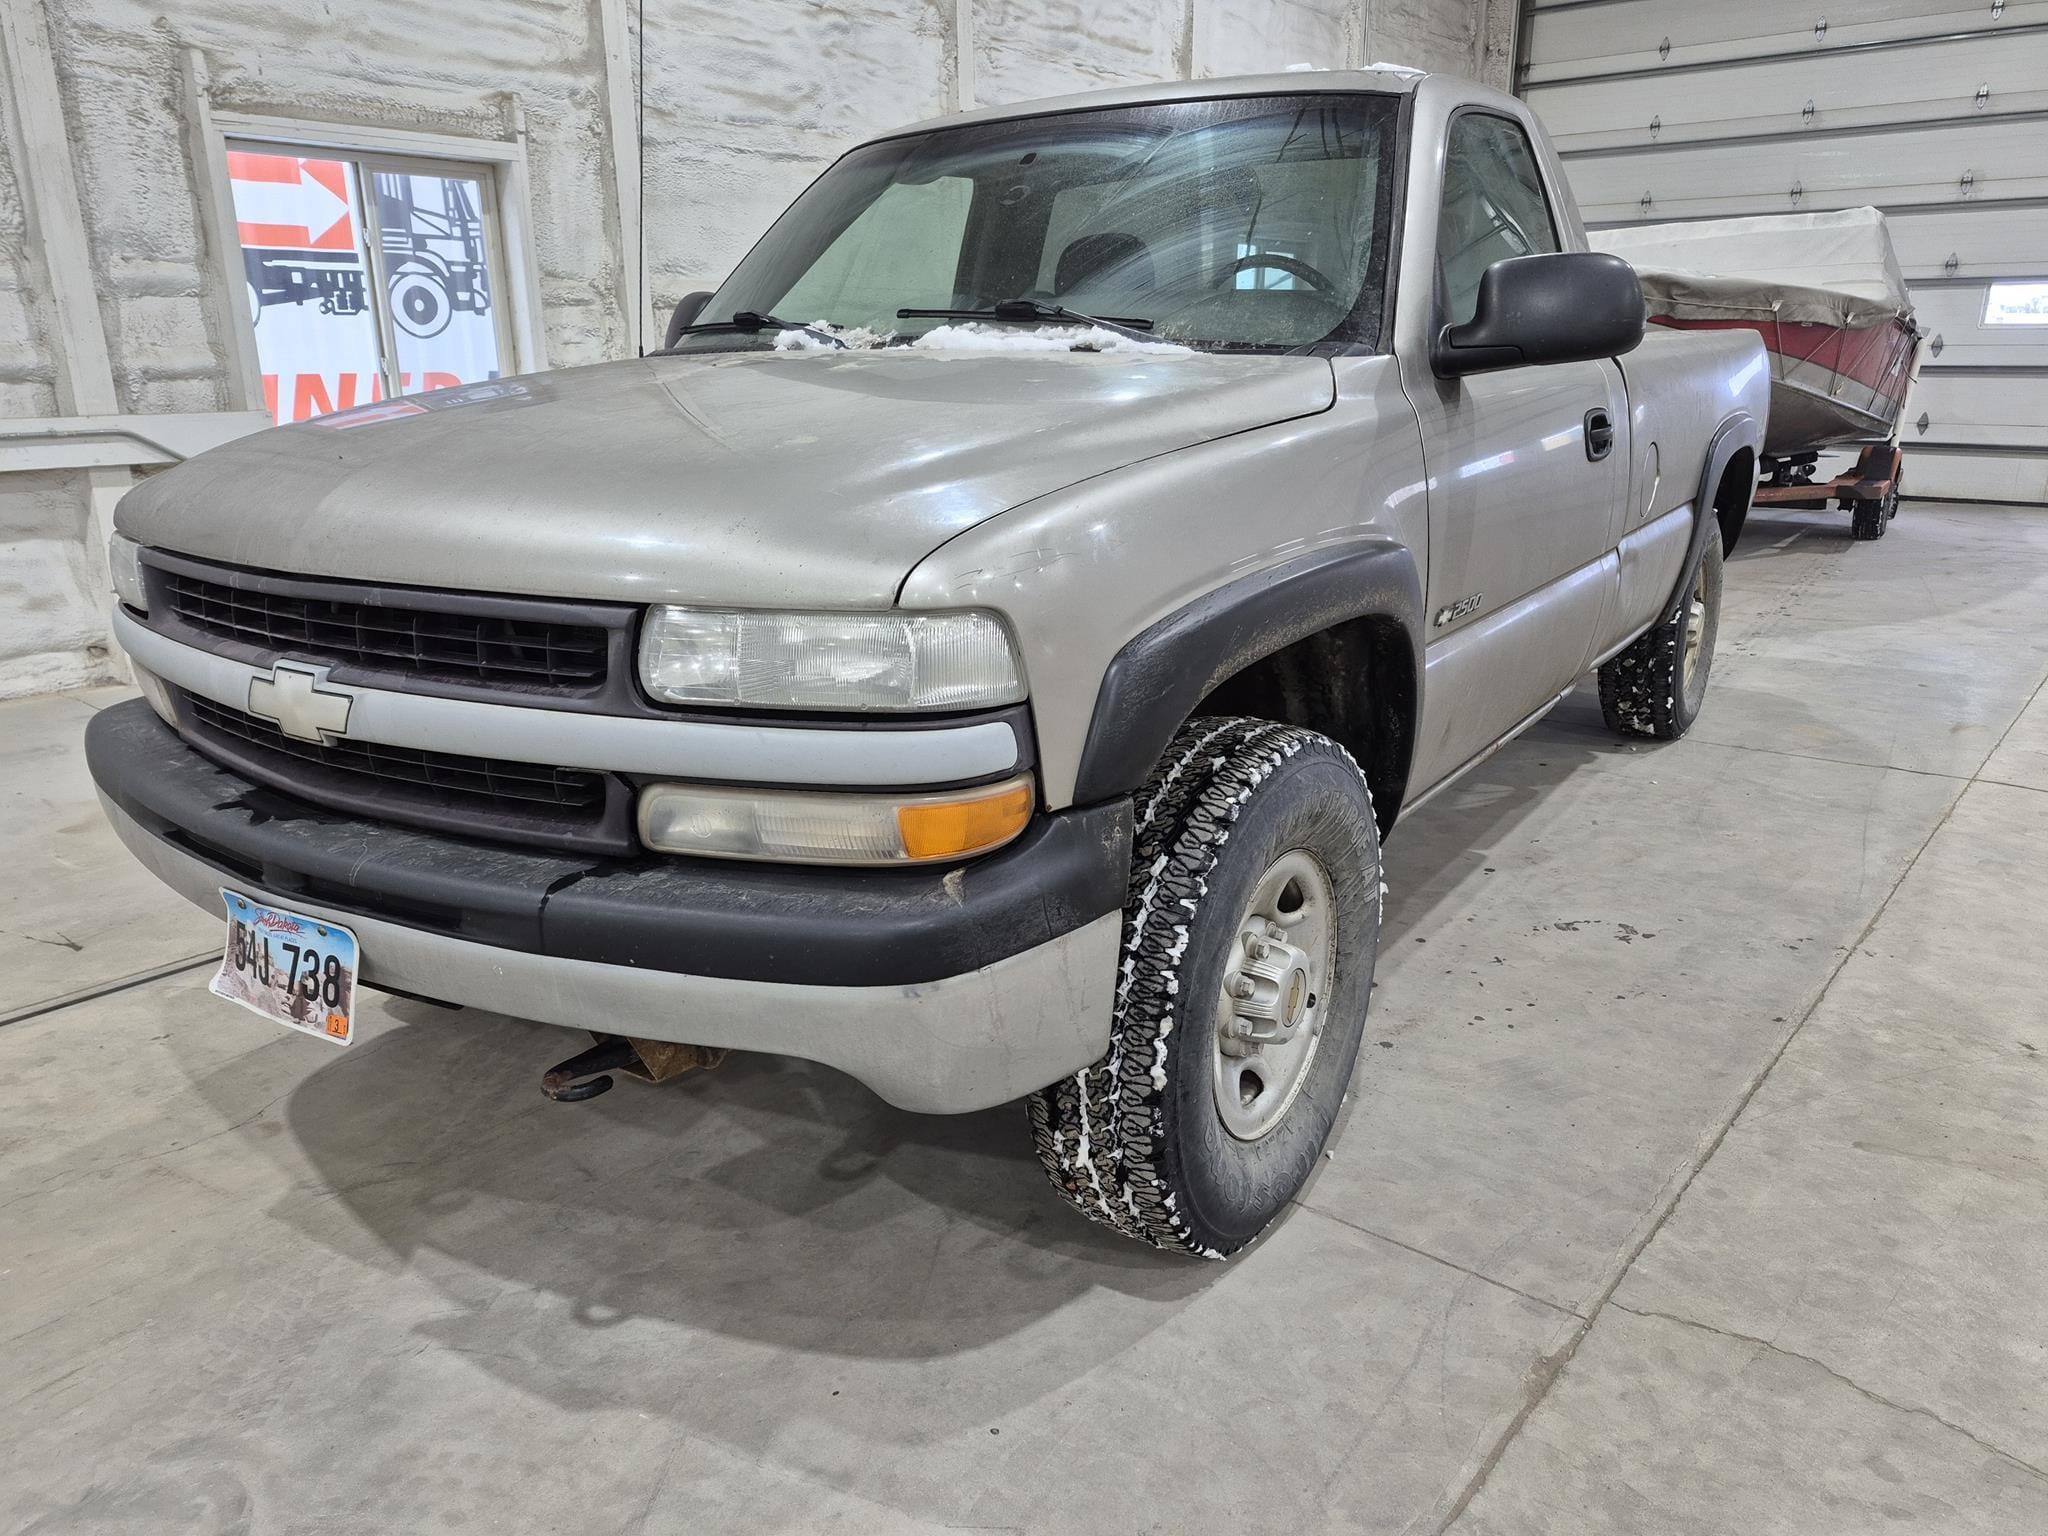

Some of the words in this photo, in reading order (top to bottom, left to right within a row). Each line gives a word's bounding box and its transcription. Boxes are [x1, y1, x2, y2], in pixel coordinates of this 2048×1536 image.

[1452, 592, 1483, 619] 2500
[235, 920, 269, 986] 54J
[282, 943, 341, 1008] 738
